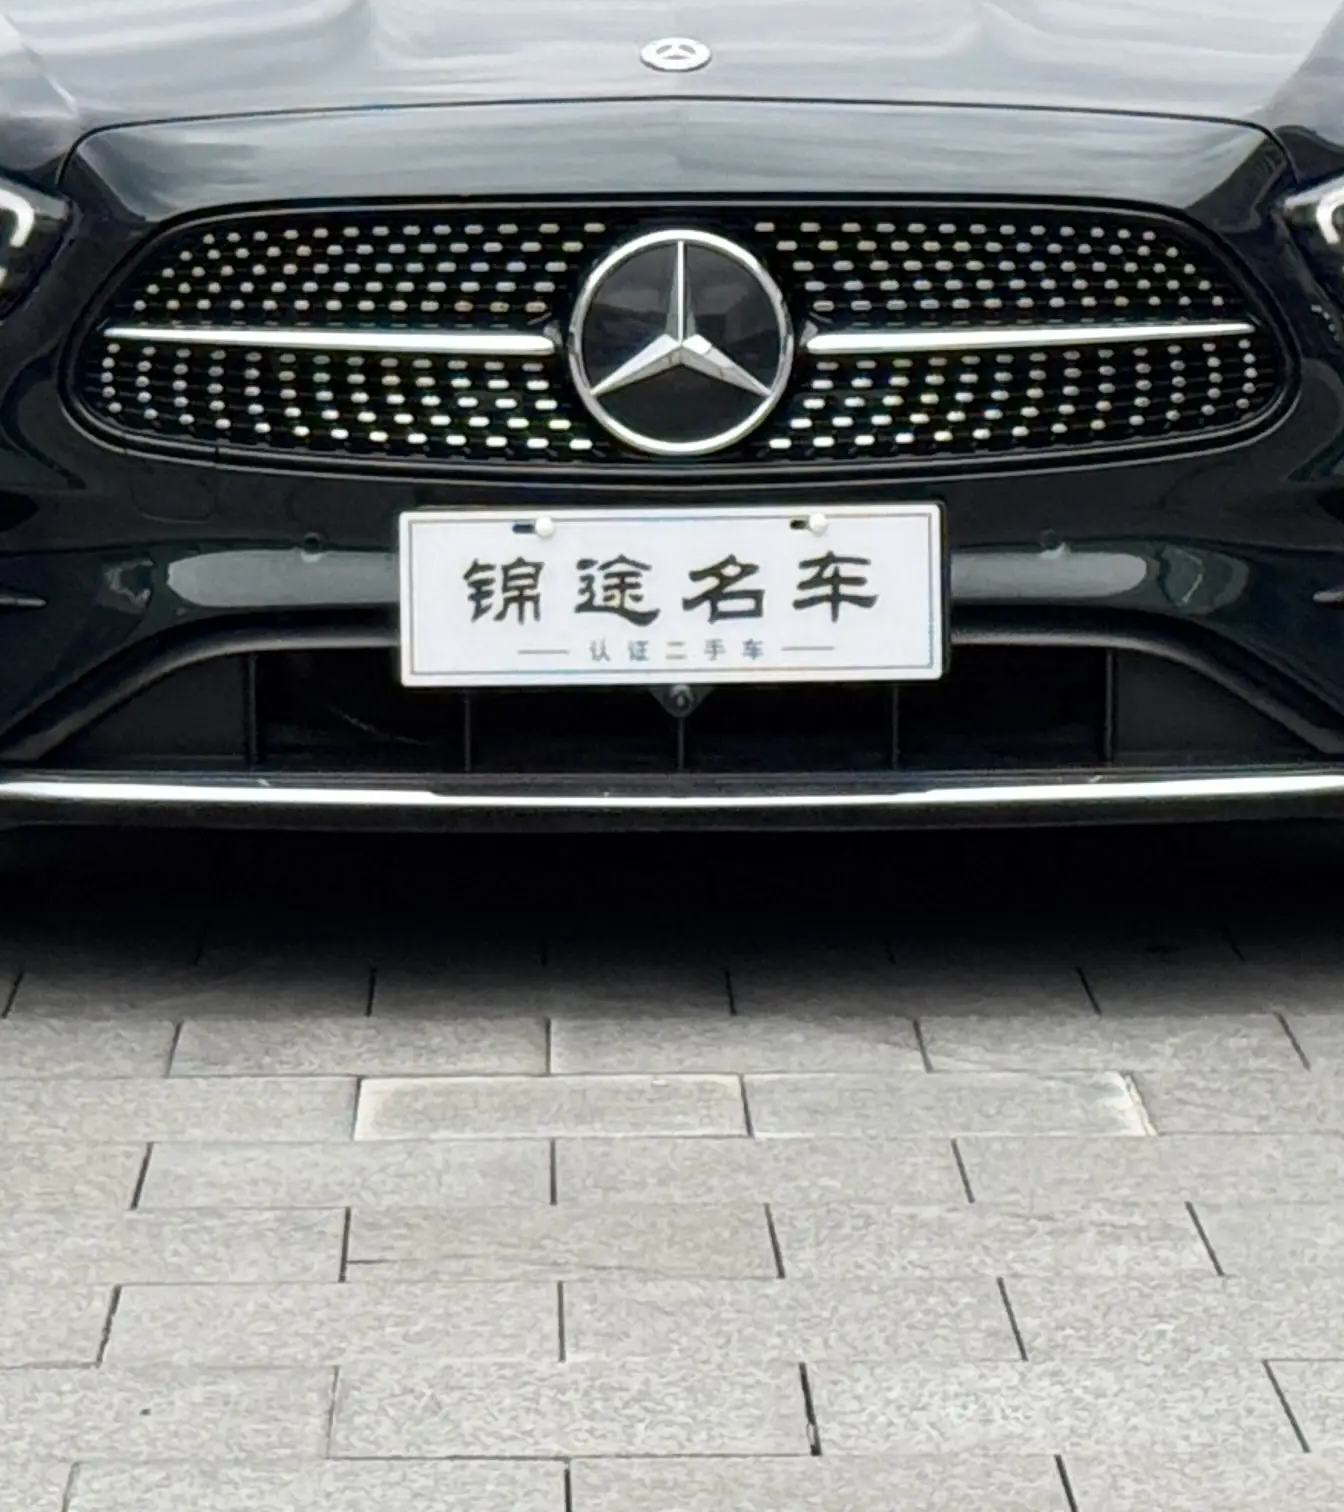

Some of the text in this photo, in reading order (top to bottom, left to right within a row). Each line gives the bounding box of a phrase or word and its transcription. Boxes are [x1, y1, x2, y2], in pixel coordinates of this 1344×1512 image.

[462, 550, 879, 626] 锦途名车
[588, 639, 765, 662] 认证二手车
